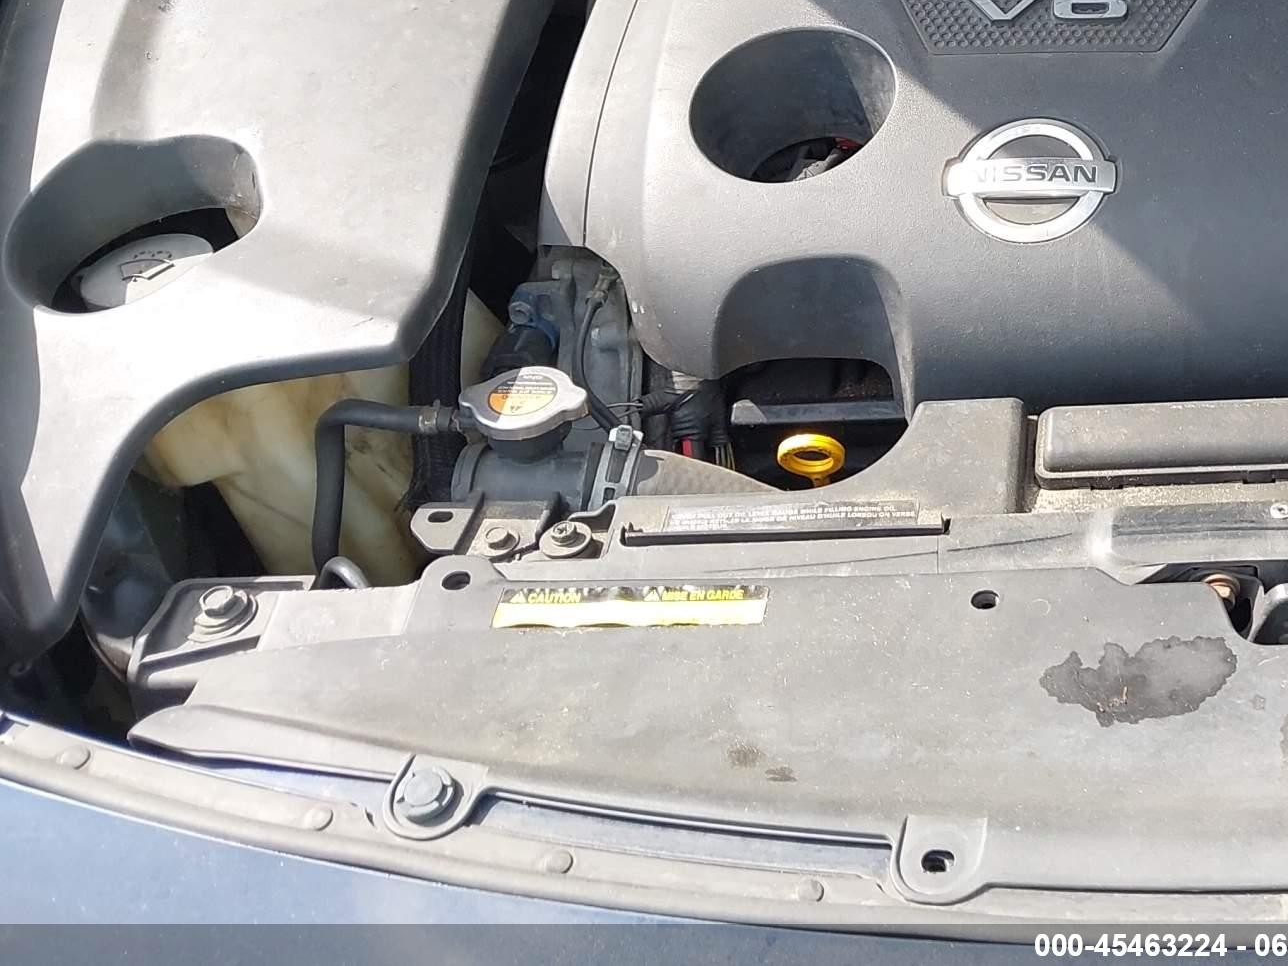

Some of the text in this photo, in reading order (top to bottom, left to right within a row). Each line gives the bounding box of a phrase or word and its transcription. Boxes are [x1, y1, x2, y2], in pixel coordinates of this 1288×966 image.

[972, 163, 1097, 184] NISSAN
[528, 592, 581, 604] CAUTION
[661, 589, 744, 601] MISE EN GARDE
